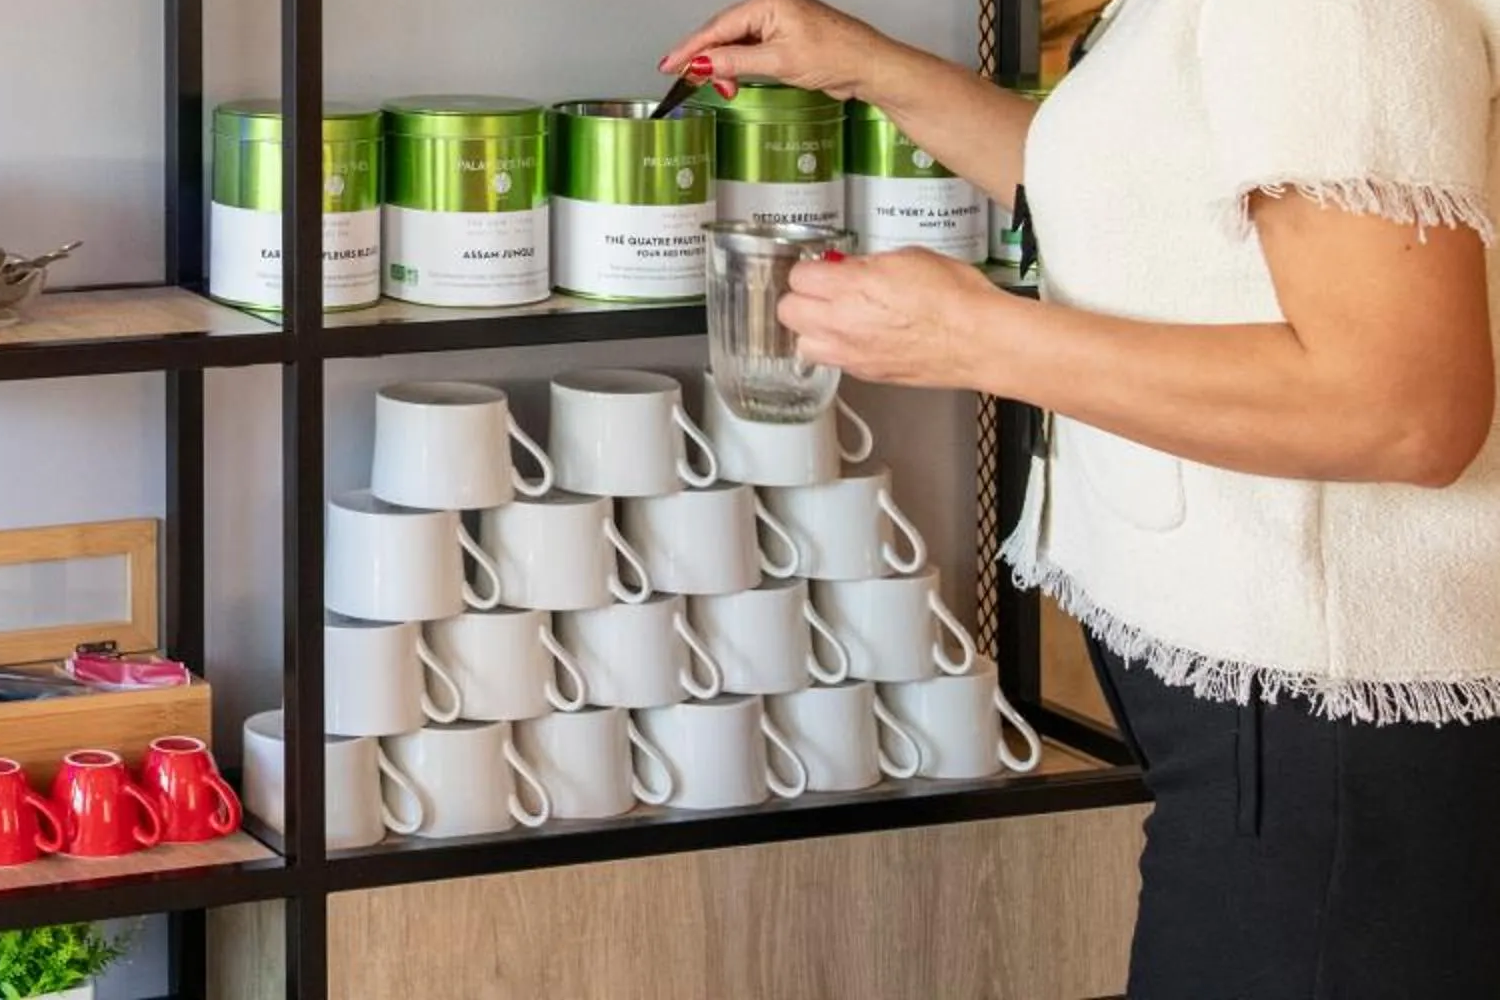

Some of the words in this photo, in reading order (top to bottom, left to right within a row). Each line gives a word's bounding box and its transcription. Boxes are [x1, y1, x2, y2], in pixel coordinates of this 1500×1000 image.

[627, 235, 670, 246] QUATRE
[260, 248, 282, 259] EAR
[463, 250, 500, 259] ASSAM
